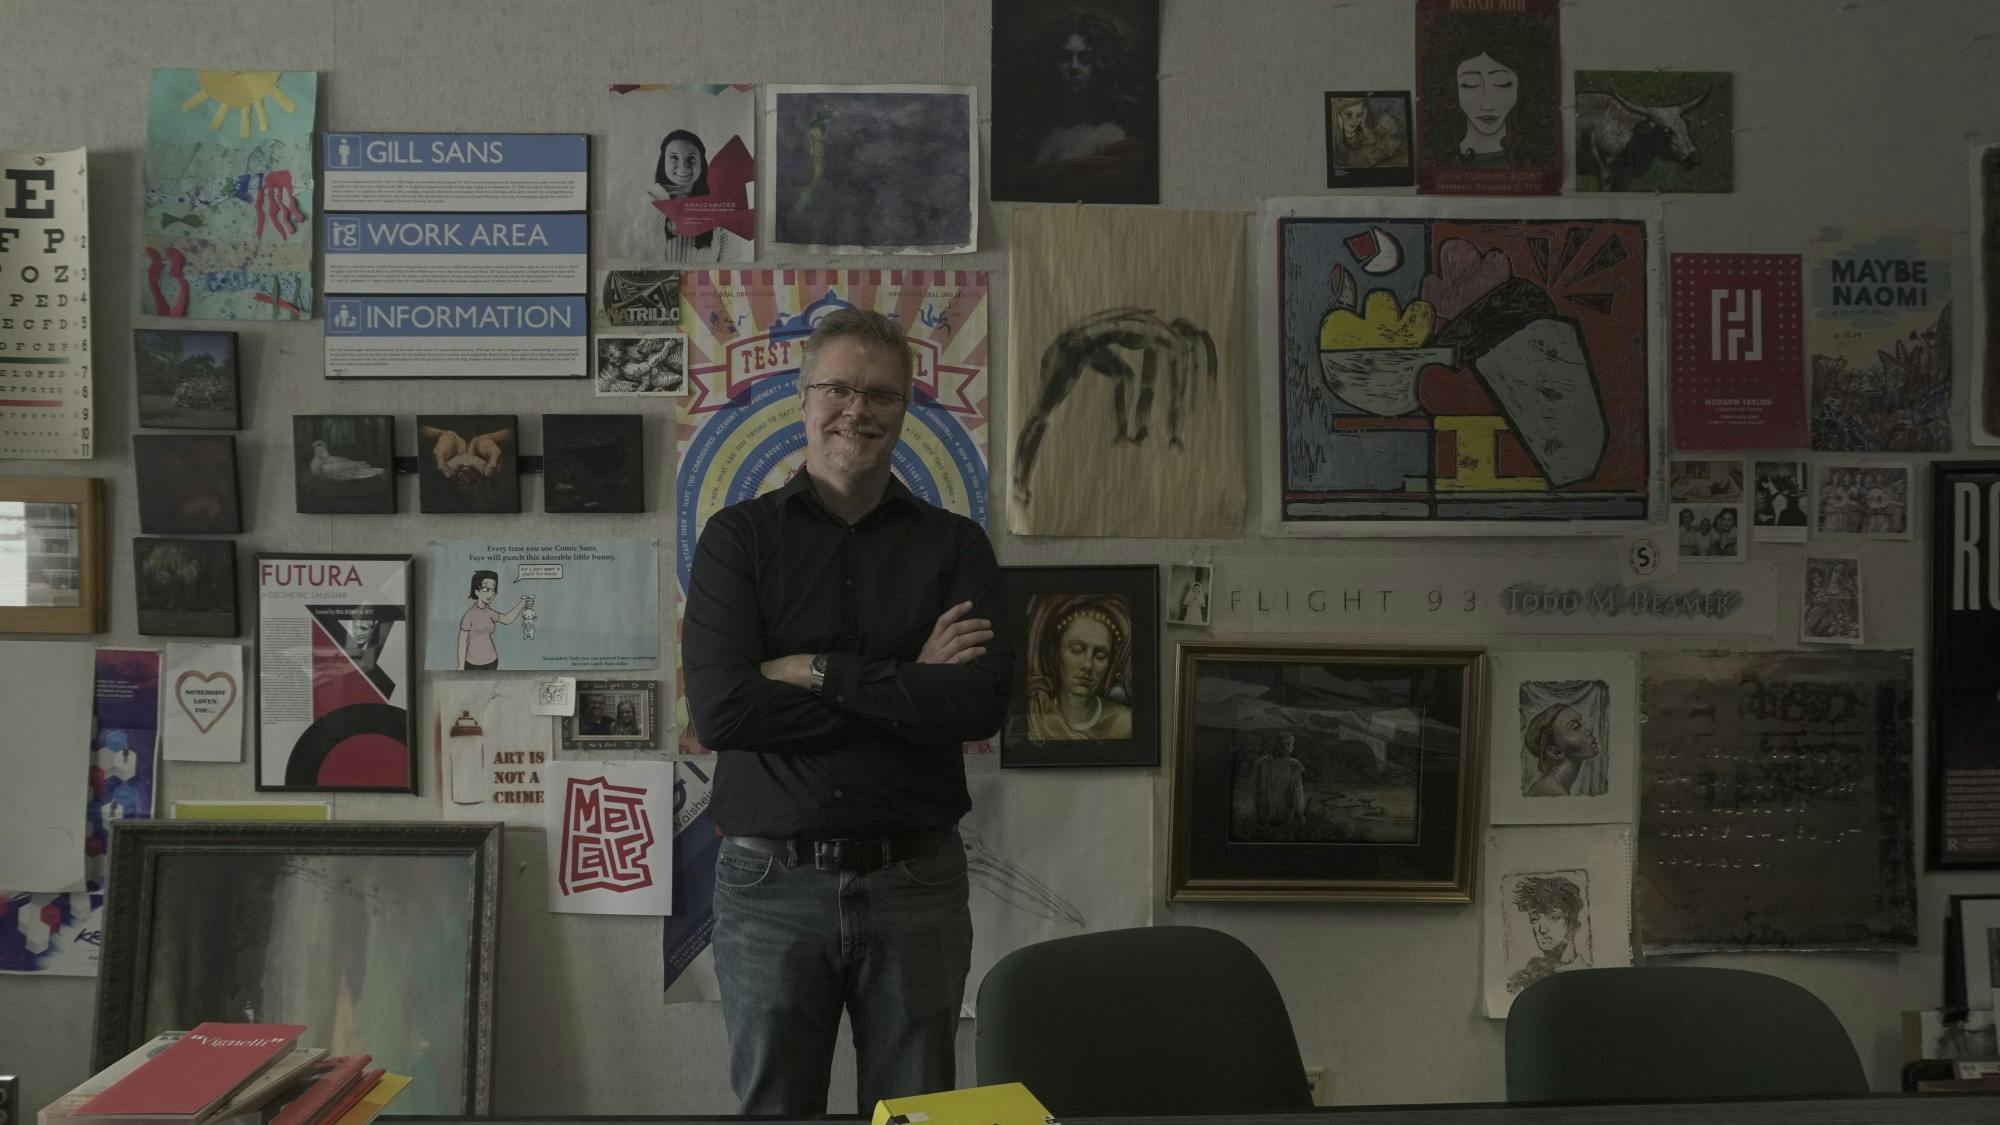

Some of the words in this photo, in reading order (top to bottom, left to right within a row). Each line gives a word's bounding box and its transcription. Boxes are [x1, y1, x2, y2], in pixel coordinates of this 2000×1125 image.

[366, 140, 423, 163] GILL
[431, 140, 503, 163] SANS
[5, 169, 55, 218] E
[44, 228, 65, 253] P
[367, 223, 463, 246] WORK
[470, 223, 548, 246] AREA
[1831, 259, 1928, 283] MAYBE
[1833, 286, 1927, 306] NAOMI
[366, 305, 571, 328] INFORMATION
[741, 340, 790, 374] TEST
[715, 411, 739, 436] ACCOUNT
[487, 545, 506, 553] Every
[502, 554, 524, 563] punch
[1637, 546, 1650, 567] S
[261, 564, 362, 586] FUTURA
[1231, 590, 1393, 612] FLIGHT
[1428, 590, 1476, 612] 93
[1633, 589, 1729, 613] BEAMER
[493, 751, 523, 764] ART
[529, 751, 544, 764] IS
[494, 771, 525, 784] NOT
[529, 771, 540, 784] A
[493, 791, 544, 803] CRIME
